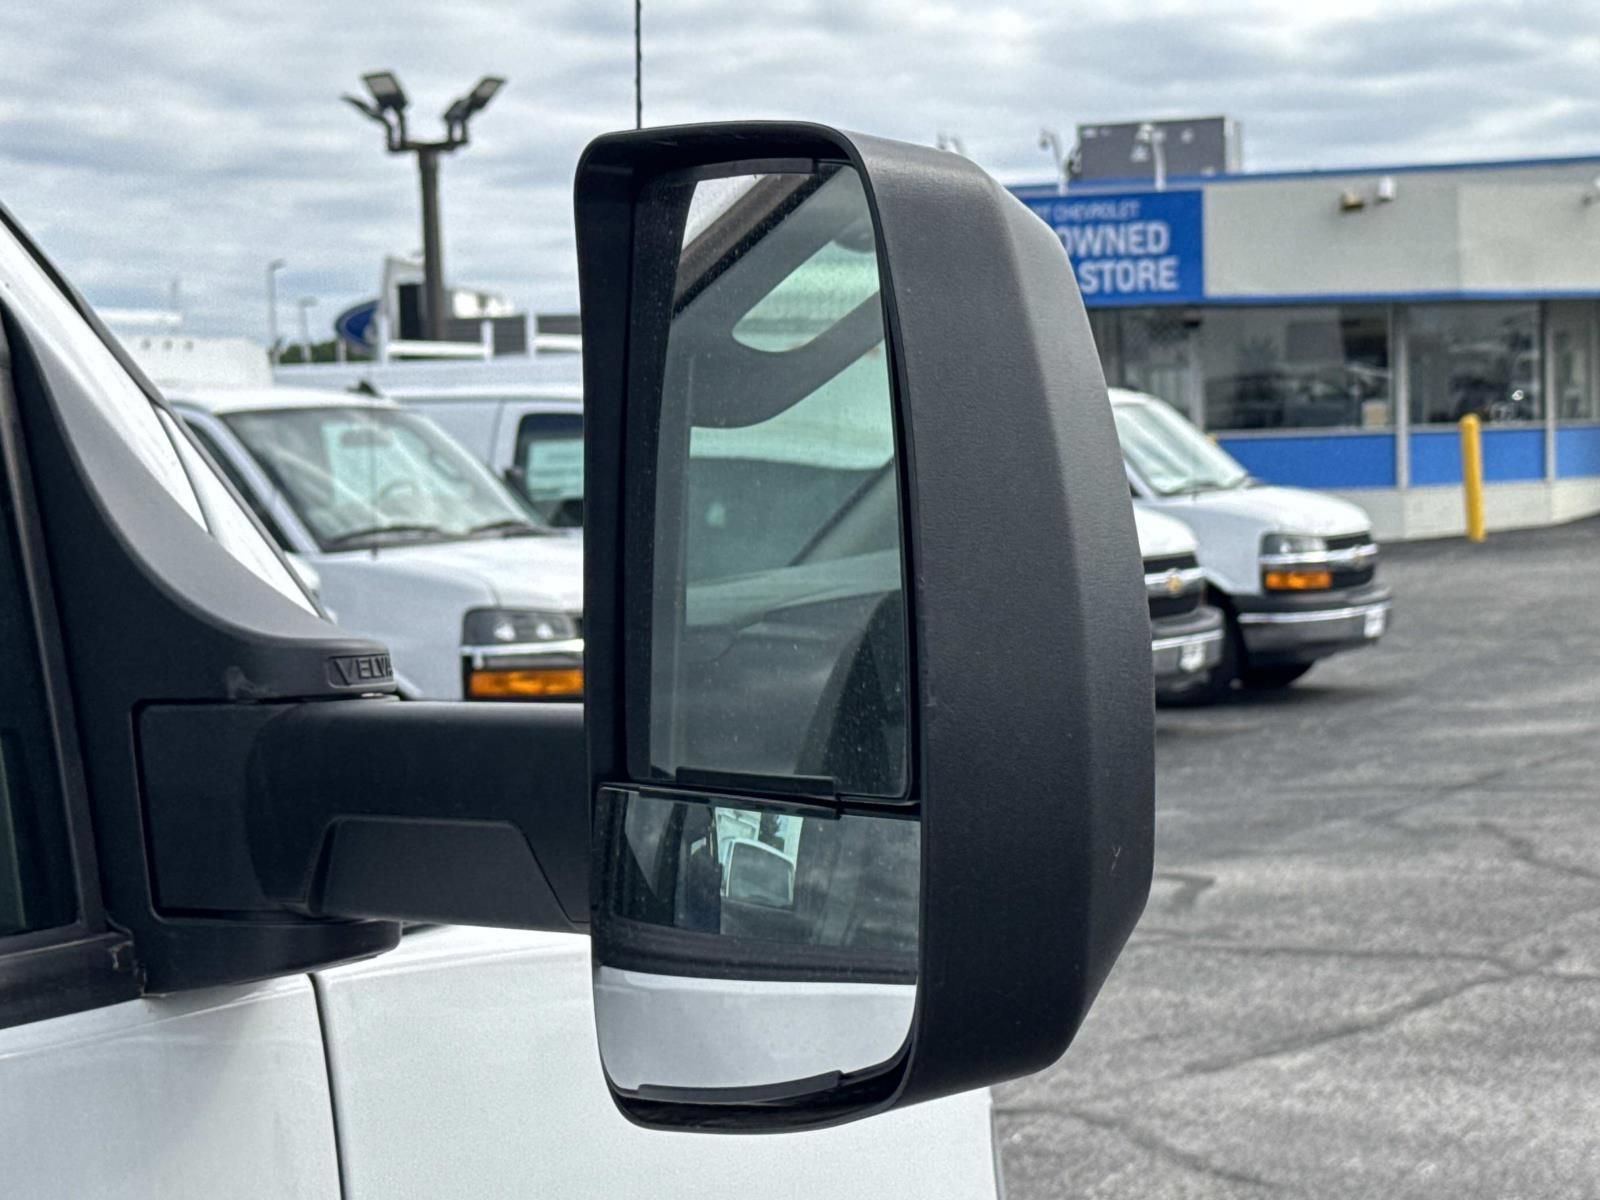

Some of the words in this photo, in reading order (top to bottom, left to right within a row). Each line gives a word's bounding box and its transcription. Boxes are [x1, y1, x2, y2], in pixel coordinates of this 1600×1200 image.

[1054, 200, 1139, 221] CHEVROLET
[1057, 220, 1169, 257] OWNED
[1078, 255, 1179, 294] STORE
